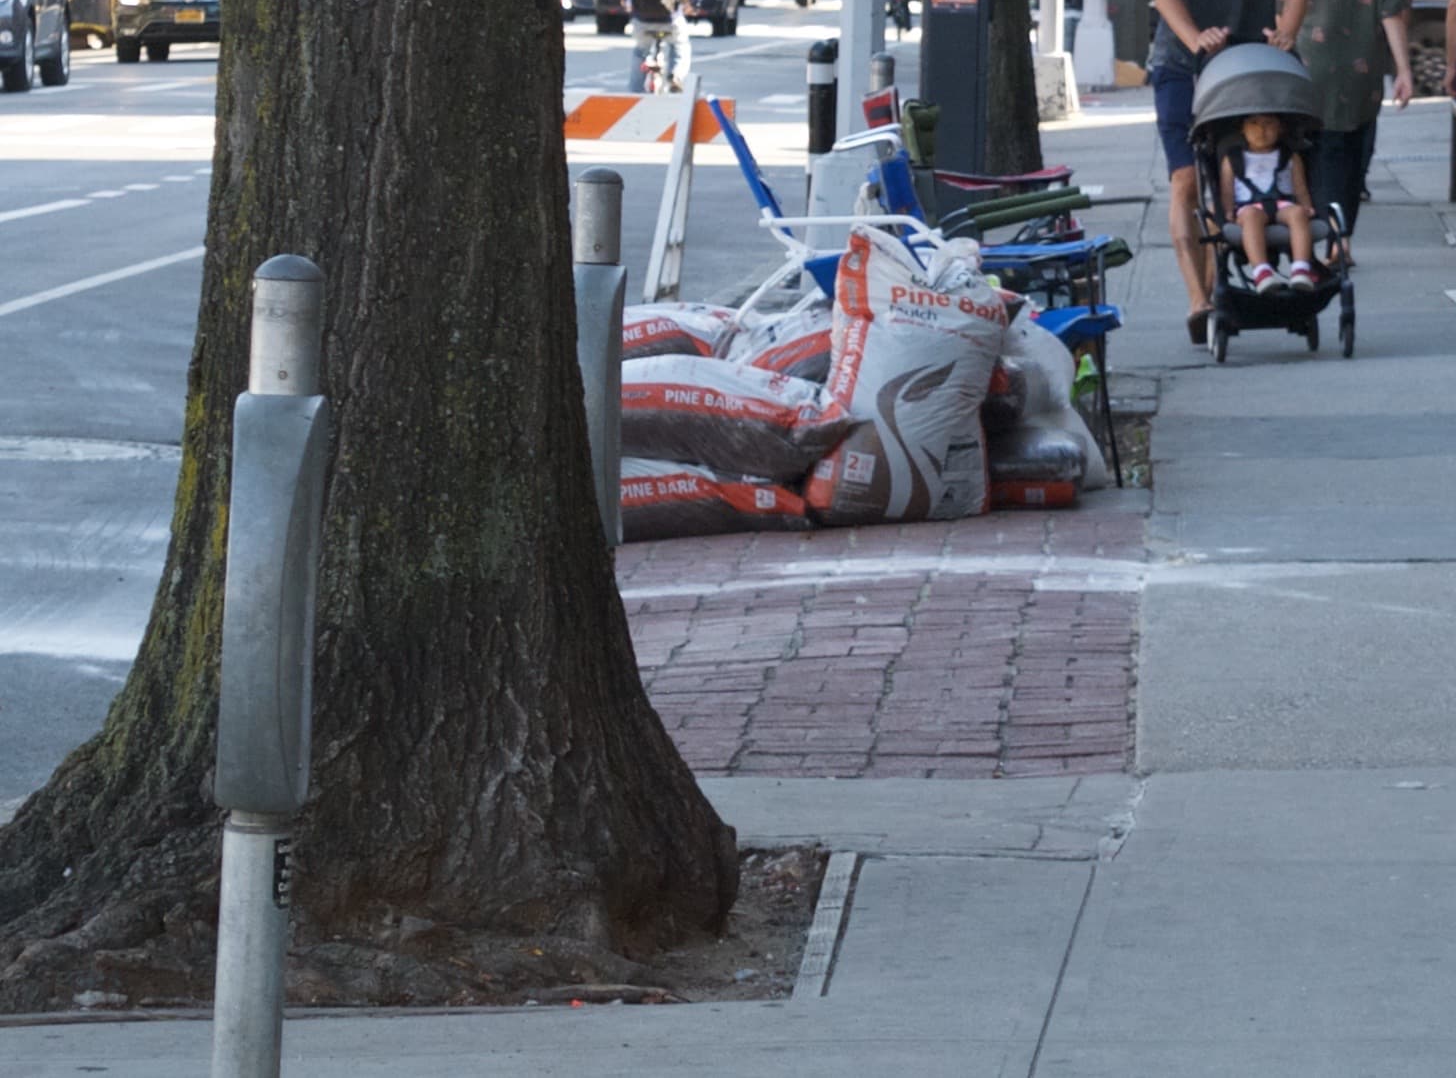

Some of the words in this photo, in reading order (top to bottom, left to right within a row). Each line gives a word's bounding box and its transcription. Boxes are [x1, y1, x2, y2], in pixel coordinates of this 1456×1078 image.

[890, 284, 951, 307] Pine
[957, 296, 1008, 330] Bark
[664, 389, 700, 405] PINE
[704, 393, 743, 411] BARK
[847, 454, 858, 470] 2
[620, 481, 654, 501] PINE
[657, 478, 699, 495] BARK
